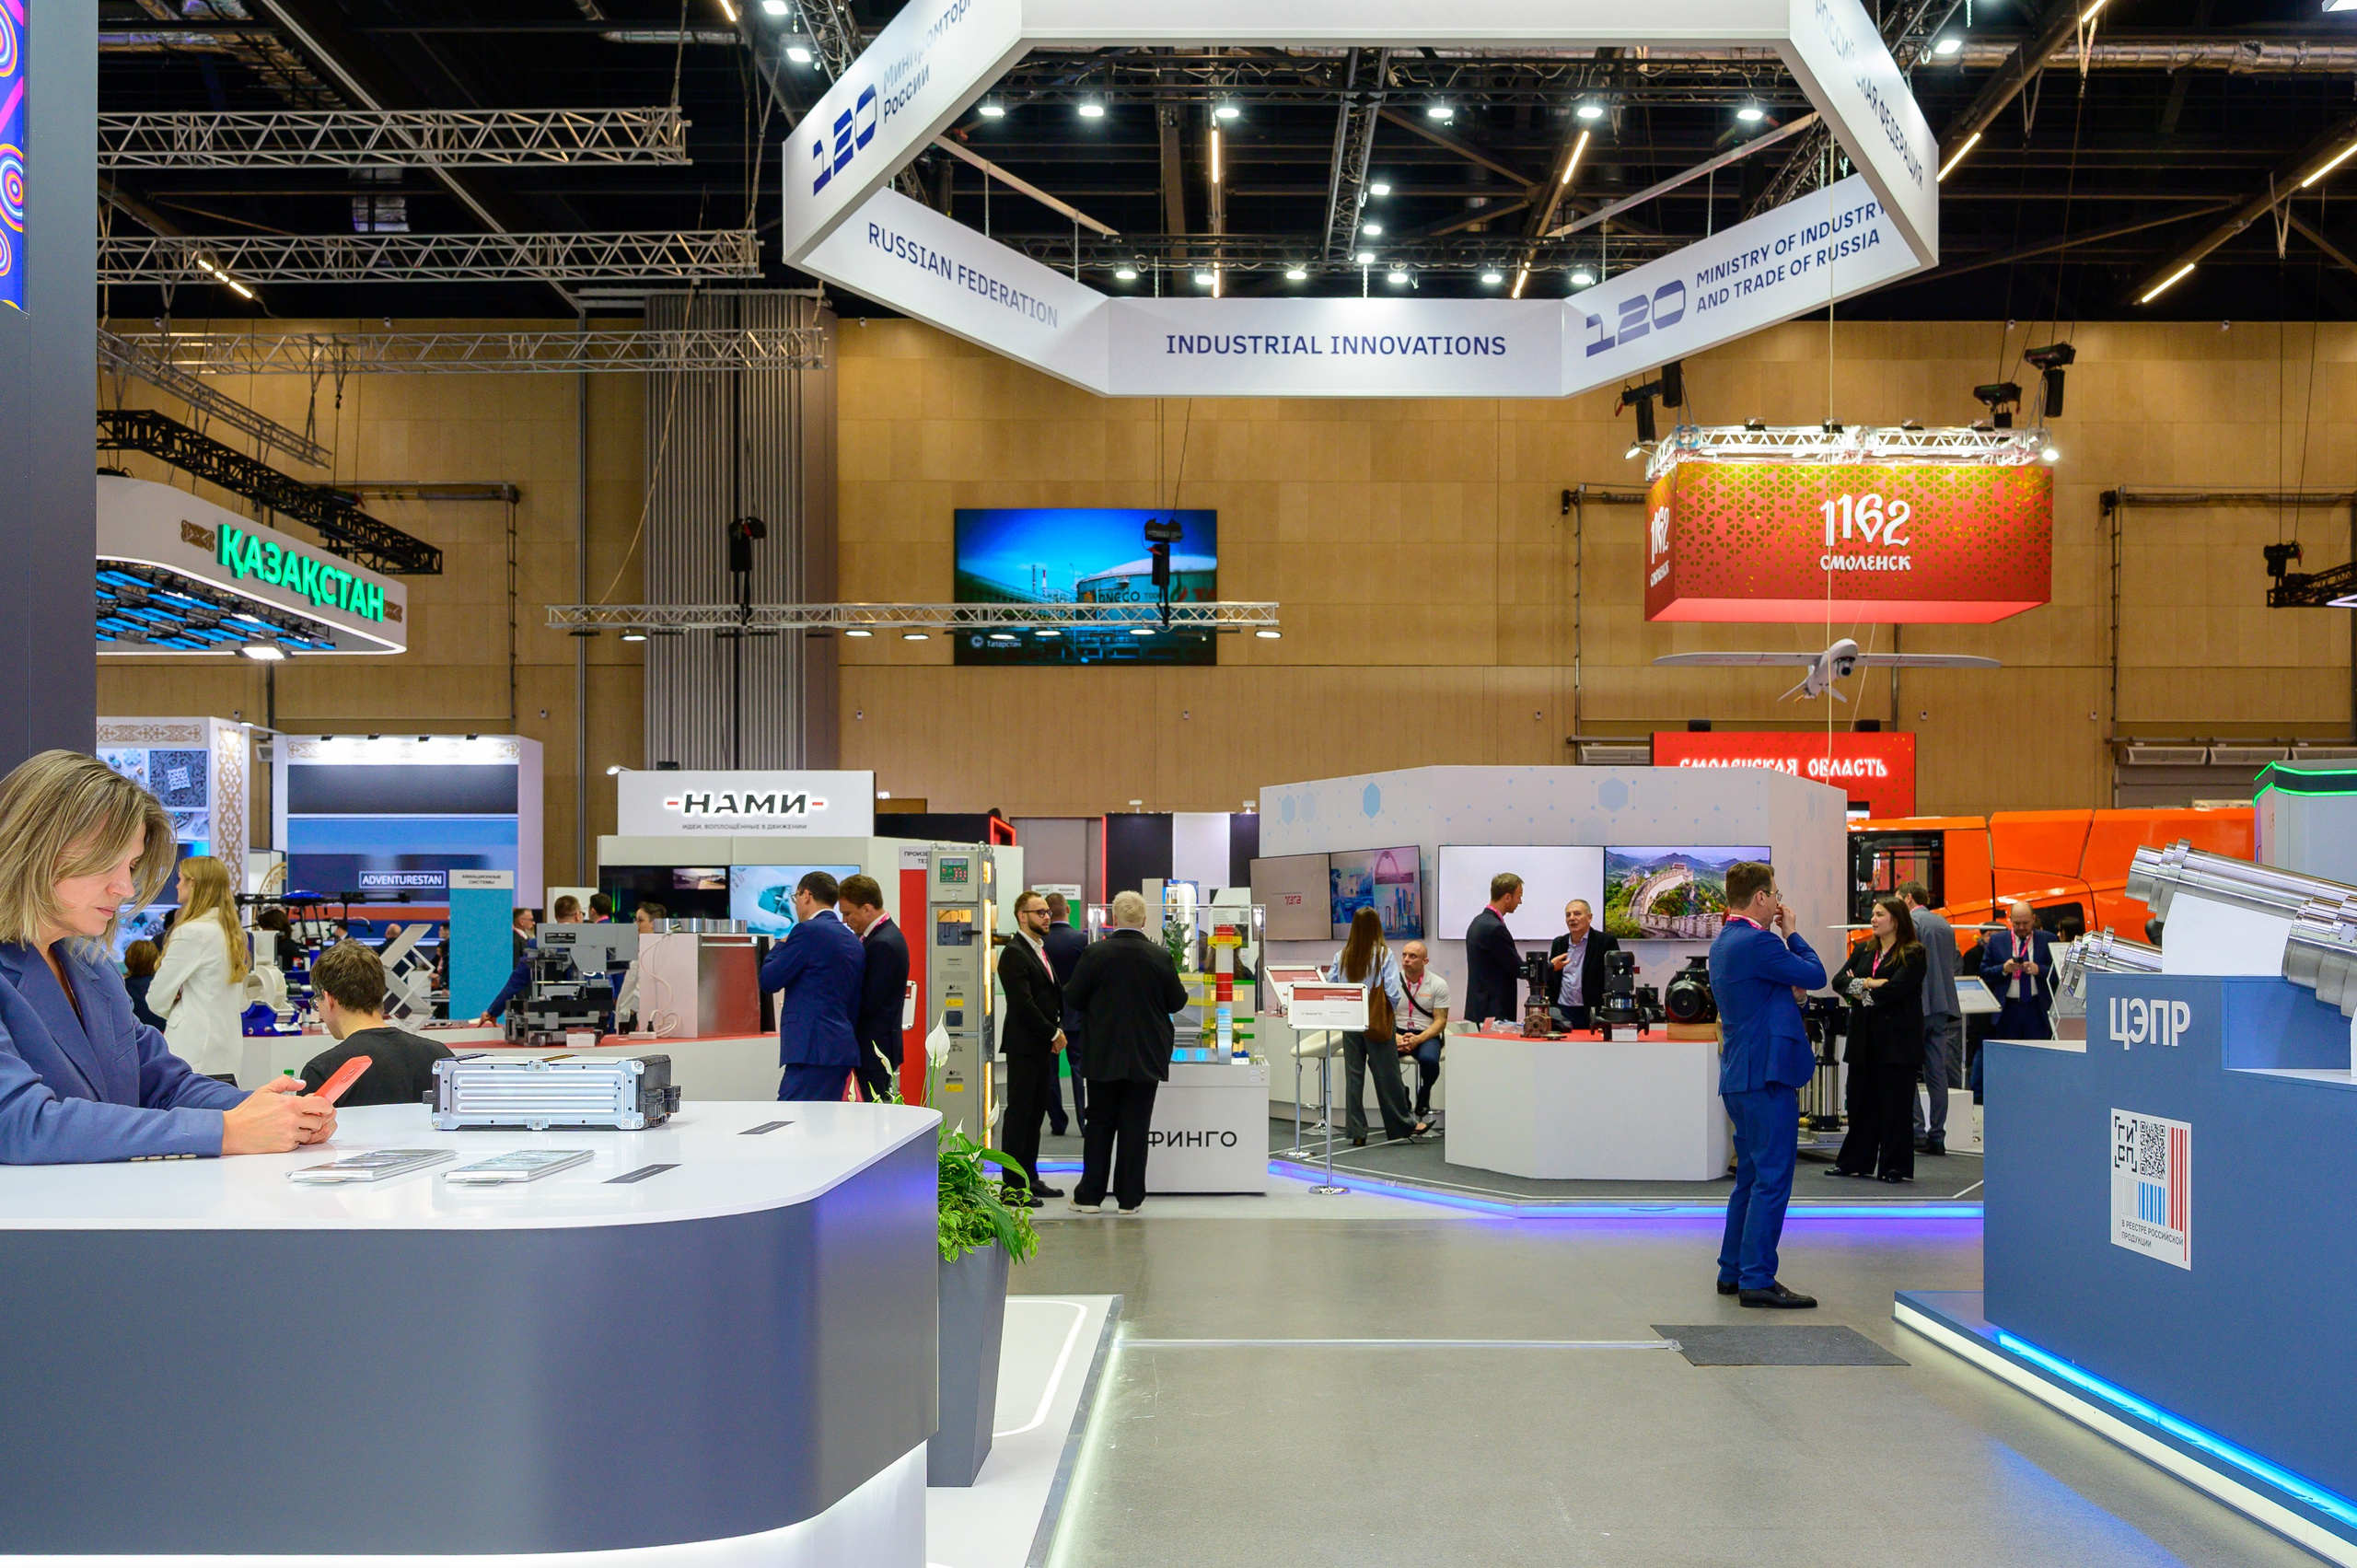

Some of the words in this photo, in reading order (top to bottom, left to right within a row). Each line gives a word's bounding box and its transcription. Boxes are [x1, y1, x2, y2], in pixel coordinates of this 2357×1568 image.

[883, 64, 930, 124] России
[1878, 98, 1923, 192] ФЕДЕРАЦИЯ
[868, 221, 952, 281] RUSSIAN
[958, 263, 1058, 329] FEDERATION
[1696, 244, 1771, 288] MINISTRY
[1774, 234, 1796, 256] OF
[1696, 287, 1729, 314] AND
[1734, 269, 1785, 297] TRADE
[1790, 254, 1811, 276] OF
[1817, 228, 1880, 265] RUSSIA
[1166, 335, 1322, 354] INDUSTRIAL
[1330, 336, 1506, 355] INNOVATIONS
[1819, 494, 1911, 547] 1162
[217, 523, 385, 623] ҚАЗАҚСТАН
[1819, 554, 1912, 572] СМОЛЕНСК
[1807, 759, 1887, 777] ОБЛАСТЬ
[684, 794, 807, 814] НАМИ
[362, 875, 442, 886] ADVENTURESTAN
[2109, 997, 2190, 1051] ЦЭПР
[1148, 1131, 1237, 1147] ФИНГО
[2120, 1219, 2126, 1228] В
[2126, 1220, 2147, 1235] РЕЕСТРЕ
[2147, 1227, 2184, 1247] РОССИЙСКОЙ
[2120, 1231, 2153, 1249] ПРОДУКЦИИ
